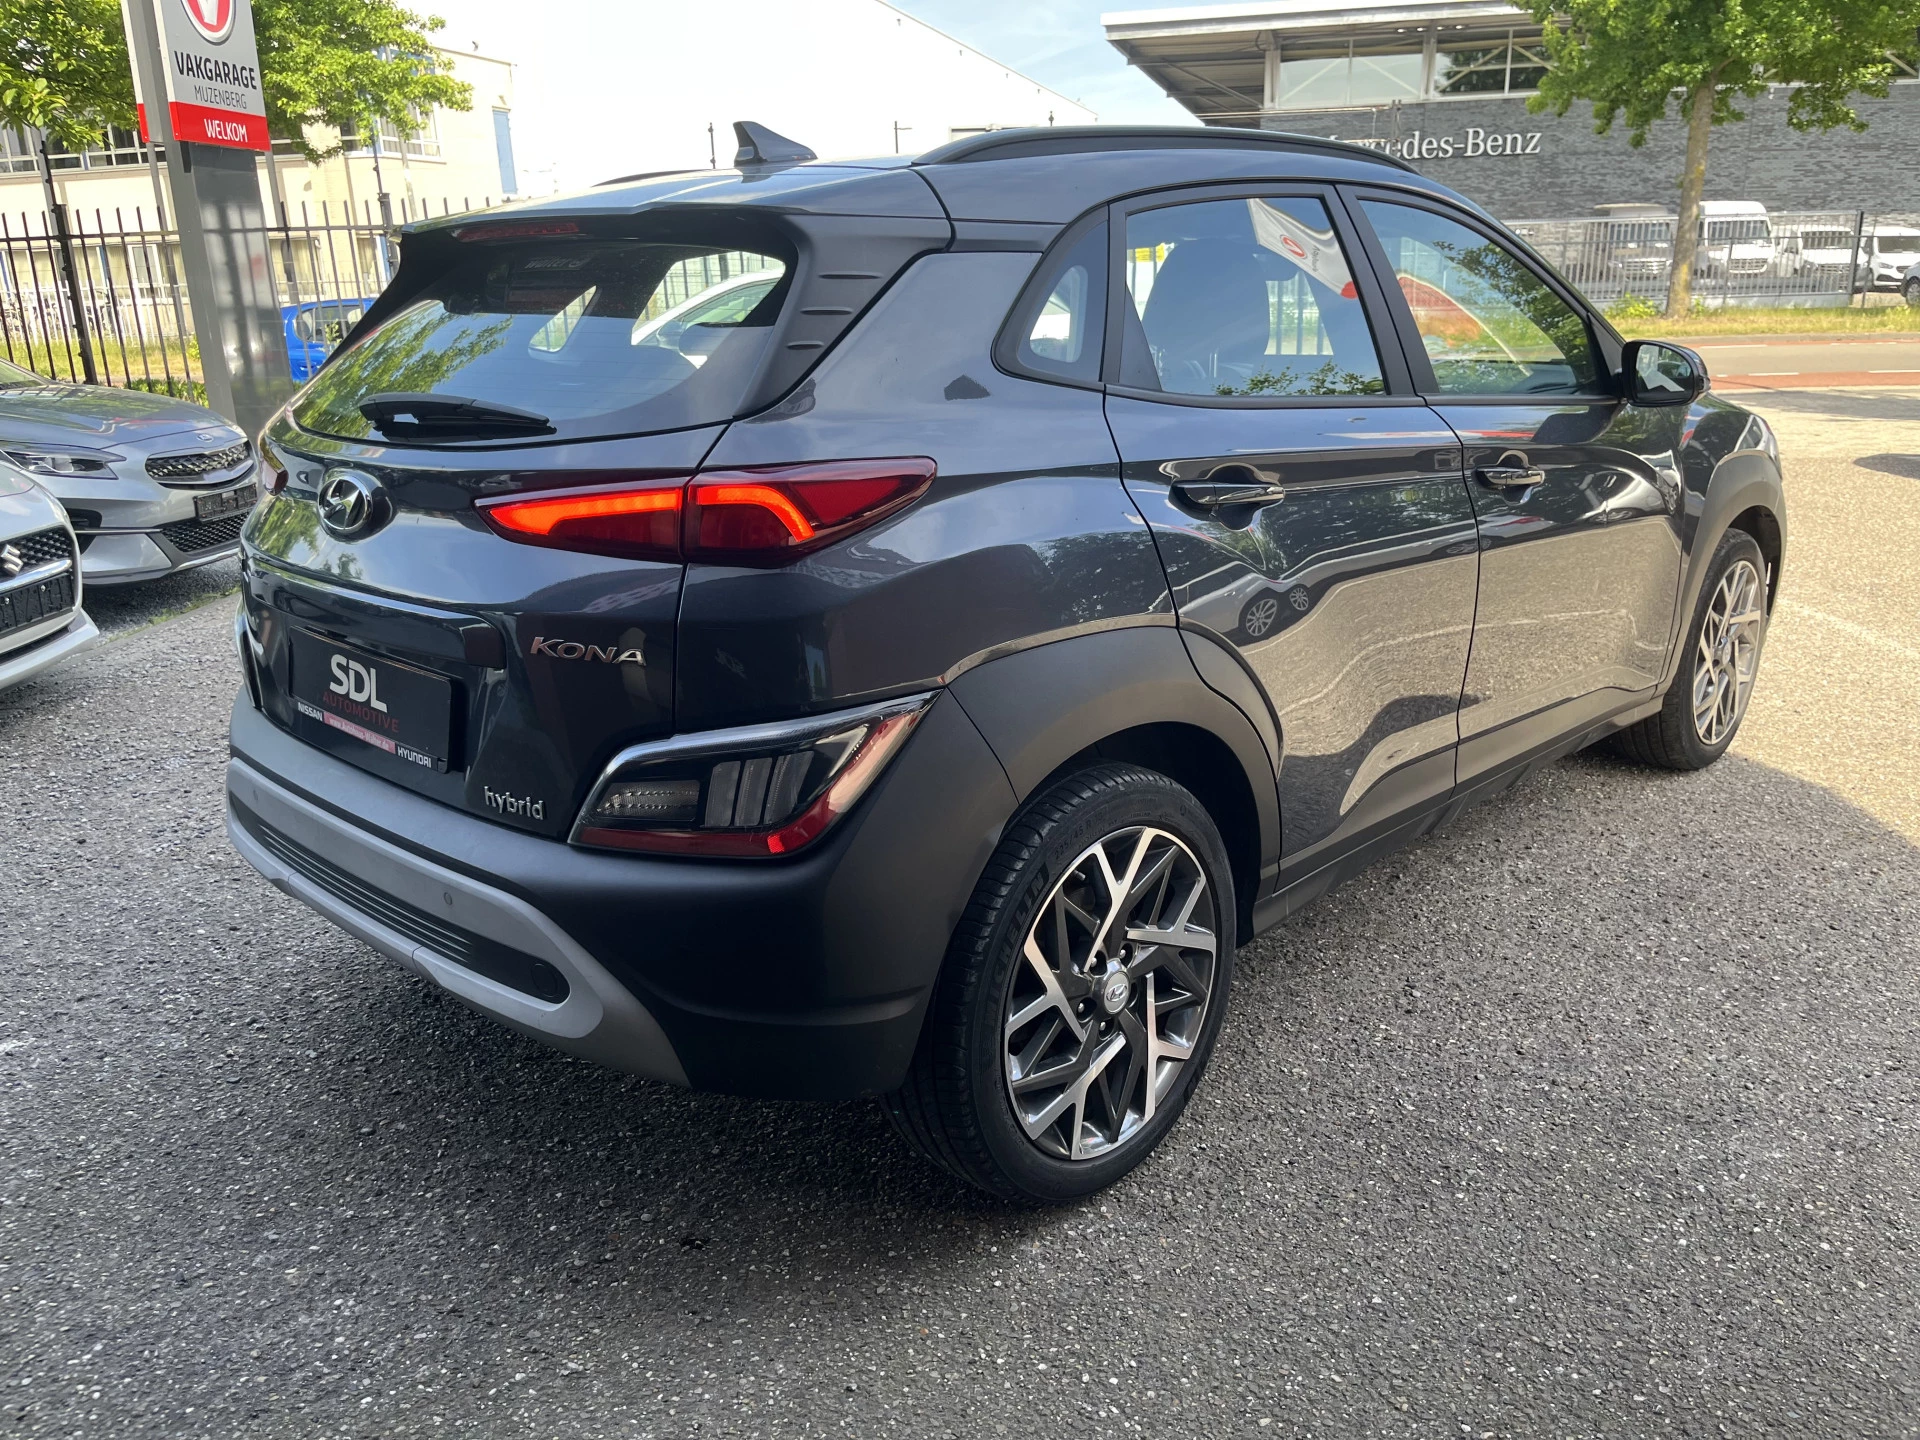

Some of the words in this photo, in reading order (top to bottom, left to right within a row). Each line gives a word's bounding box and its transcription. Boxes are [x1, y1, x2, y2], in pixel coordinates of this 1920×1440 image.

[174, 50, 257, 90] VAKGARAGE
[194, 84, 247, 109] MUZENBERG
[203, 118, 248, 143] WELKOM
[530, 636, 647, 667] KONA
[329, 653, 388, 713] SDL
[322, 691, 400, 733] AUTOMOTIVE
[297, 701, 323, 722] NISSAN
[397, 745, 432, 768] HYUNDAI
[484, 785, 545, 820] hybrid
